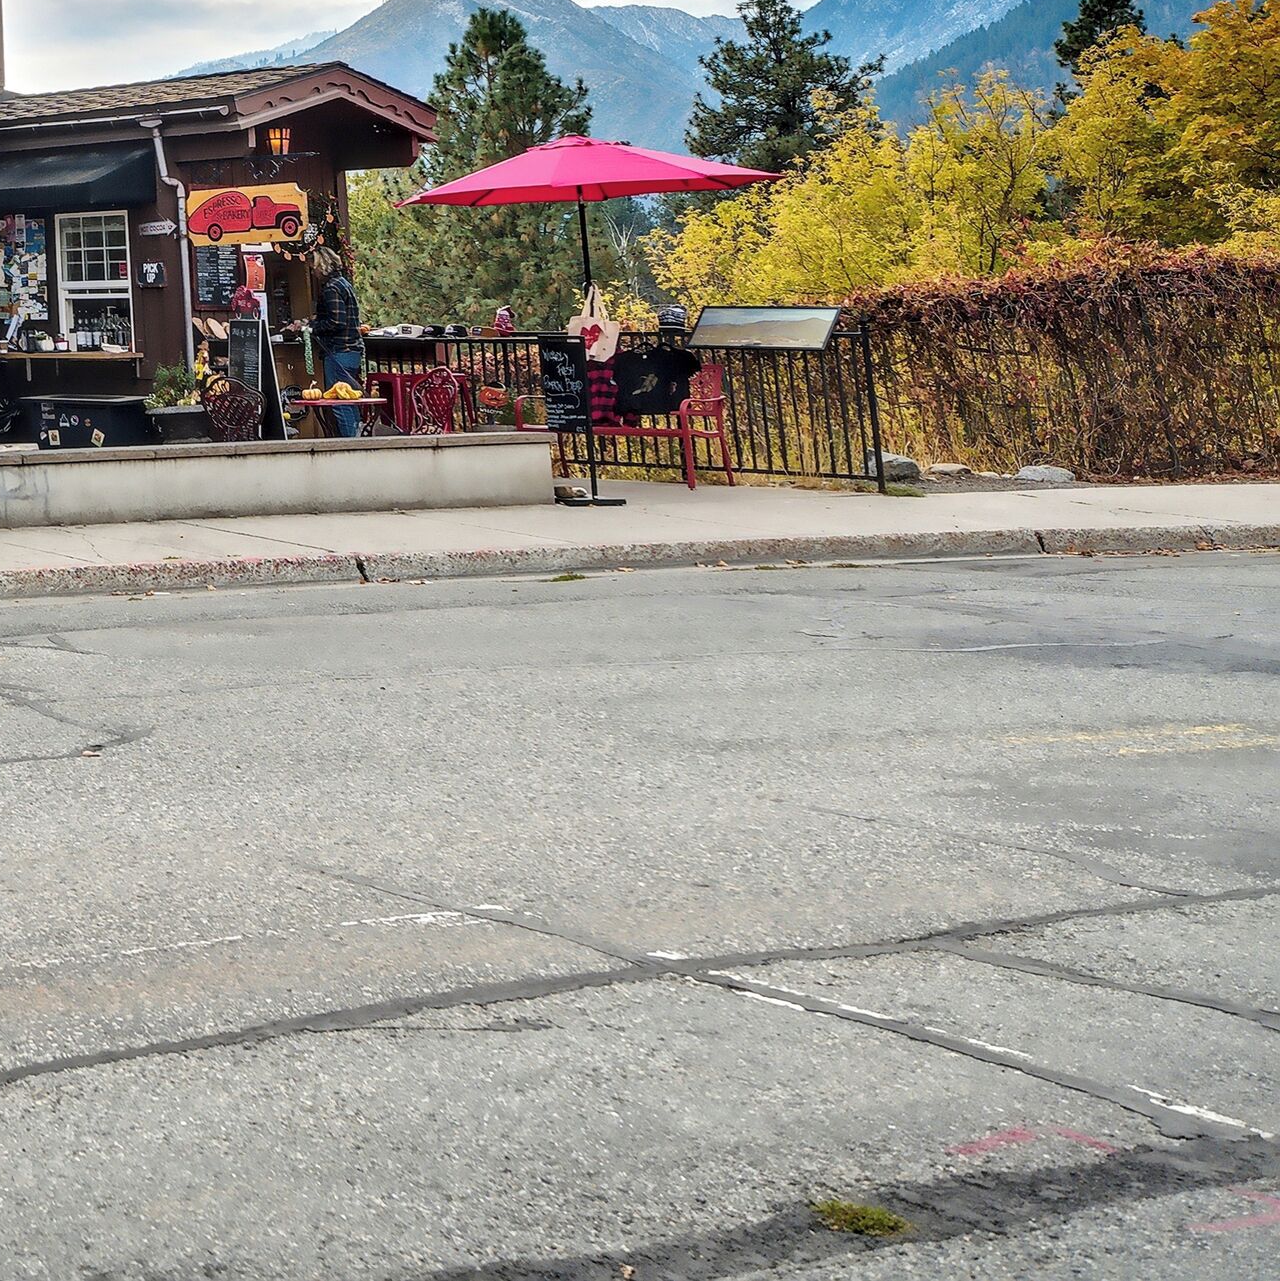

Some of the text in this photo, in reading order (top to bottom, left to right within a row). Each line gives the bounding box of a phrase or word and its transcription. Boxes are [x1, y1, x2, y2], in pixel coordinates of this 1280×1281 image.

[203, 195, 241, 219] ESPRESSO
[223, 209, 250, 220] BAKERY
[143, 263, 159, 274] PICK
[146, 273, 156, 283] UP
